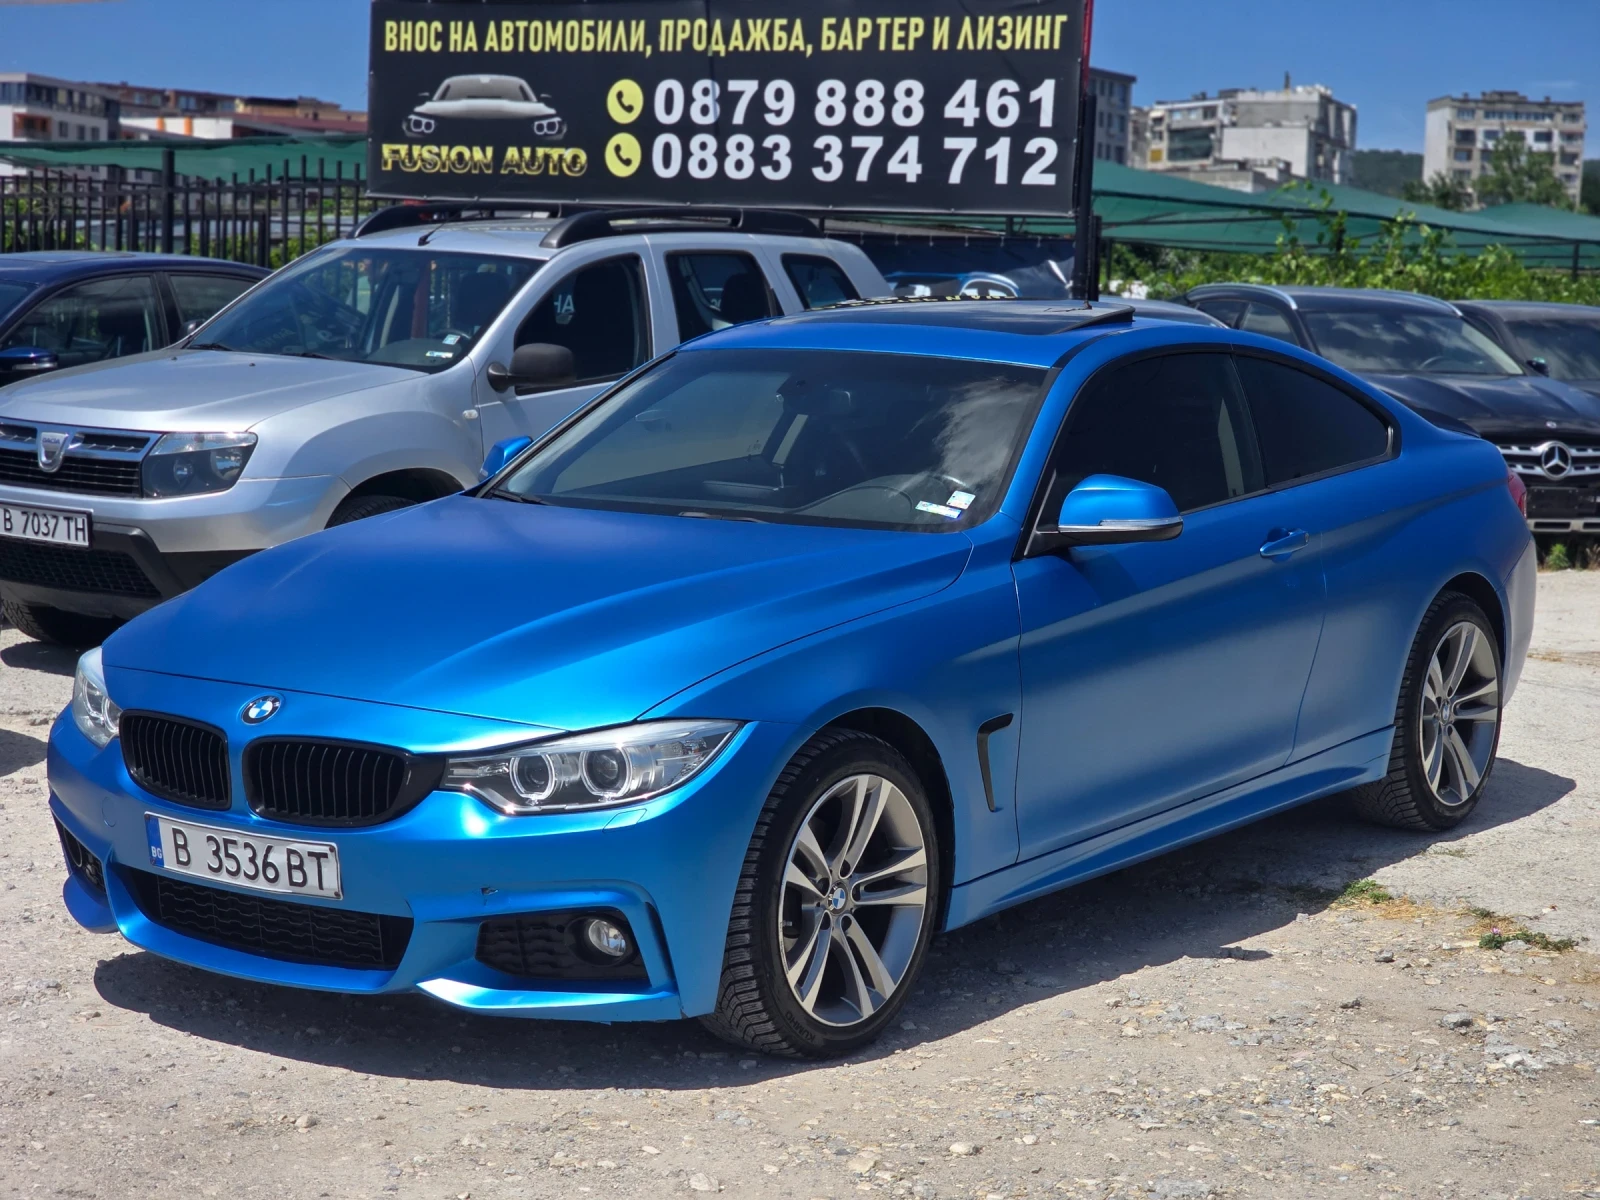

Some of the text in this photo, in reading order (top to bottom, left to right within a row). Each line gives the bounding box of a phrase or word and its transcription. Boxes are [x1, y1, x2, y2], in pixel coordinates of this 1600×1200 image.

[384, 13, 1068, 58] ВНОС НА АВТОМОБИЛИ, ПРОДАЖБА, БАРТЕР И ЛИЗИНГ
[653, 78, 1057, 128] 0879 888 461
[381, 143, 588, 177] FUSION AUTO
[651, 132, 1059, 186] 0883 374 712
[21, 511, 60, 539] 7037
[151, 845, 163, 859] BG
[206, 834, 280, 884] 3536
